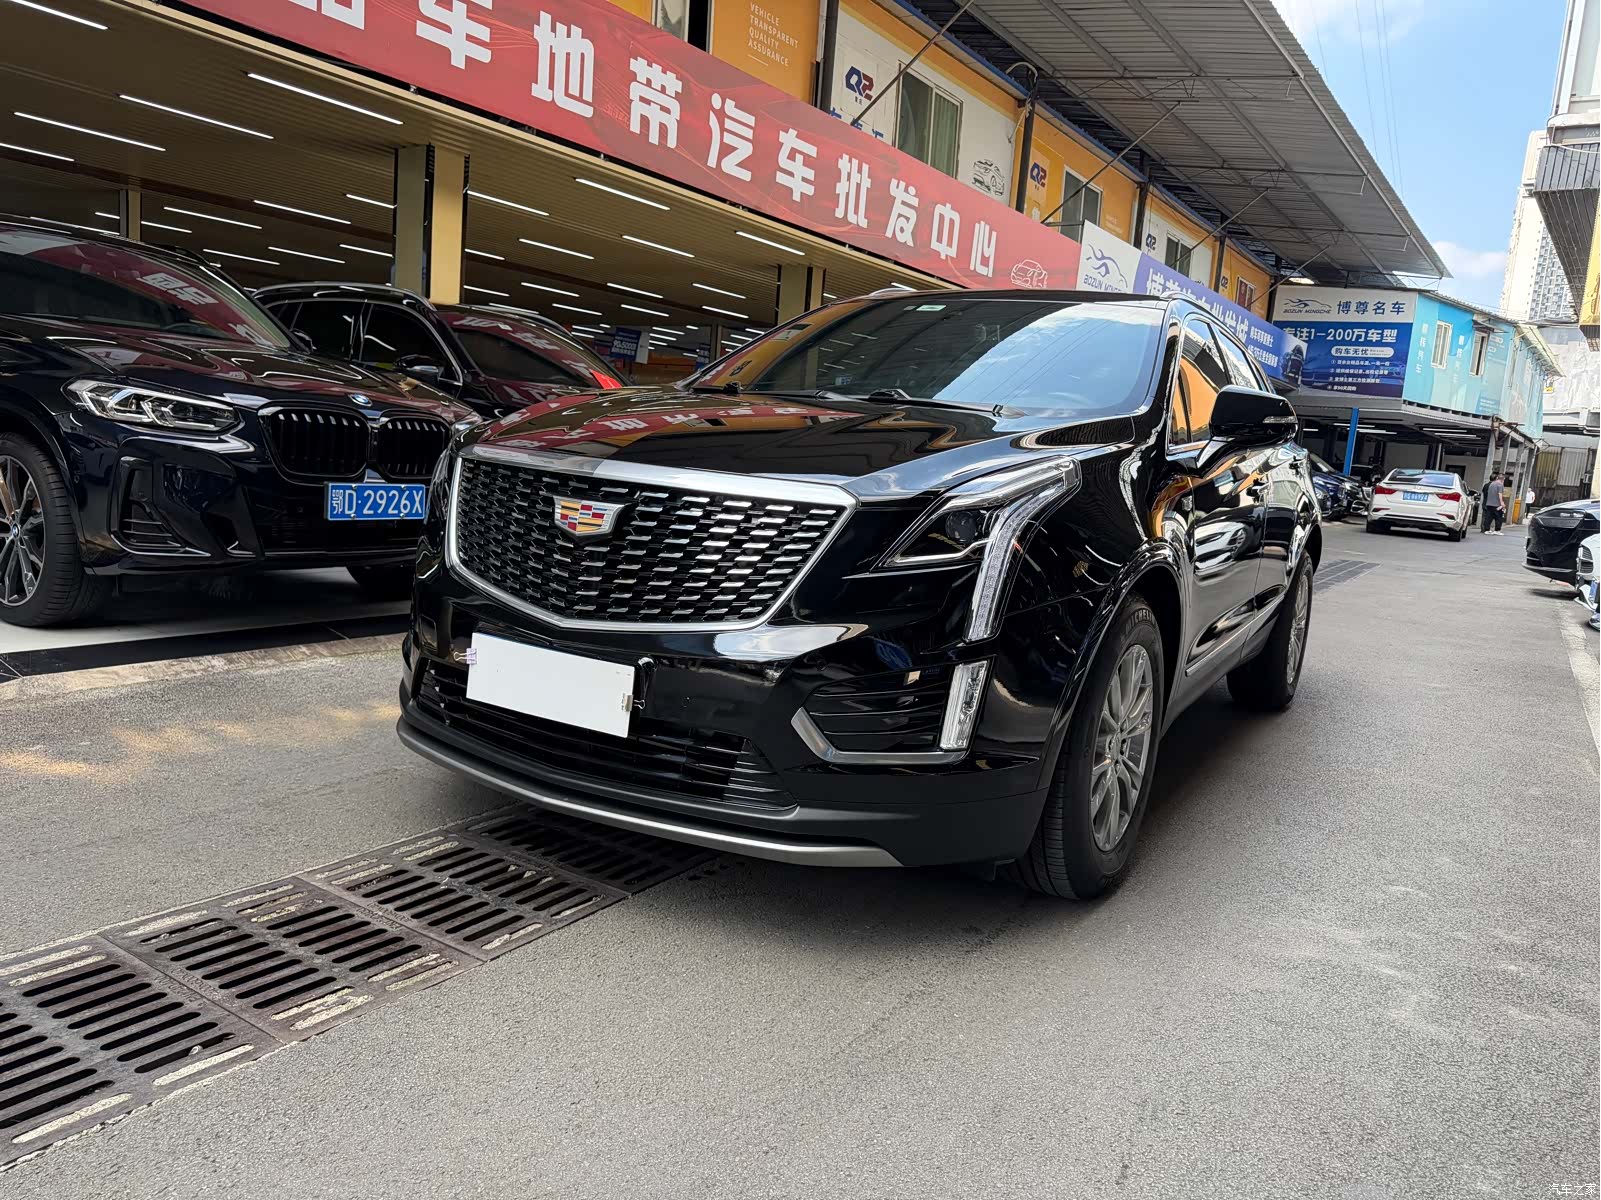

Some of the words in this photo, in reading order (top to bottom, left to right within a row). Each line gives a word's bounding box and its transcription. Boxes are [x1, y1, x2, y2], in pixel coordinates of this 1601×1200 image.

[750, 3, 780, 26] VEHICLE
[748, 27, 779, 49] QUALITY
[749, 15, 799, 48] TRANSPARENT
[748, 38, 789, 66] ASSURANCE
[289, 0, 997, 278] 车地带汽车批发中心
[1337, 300, 1406, 315] 博尊名车
[1334, 347, 1369, 356] 购车无忧
[331, 489, 423, 515] 鄂D·2926X
